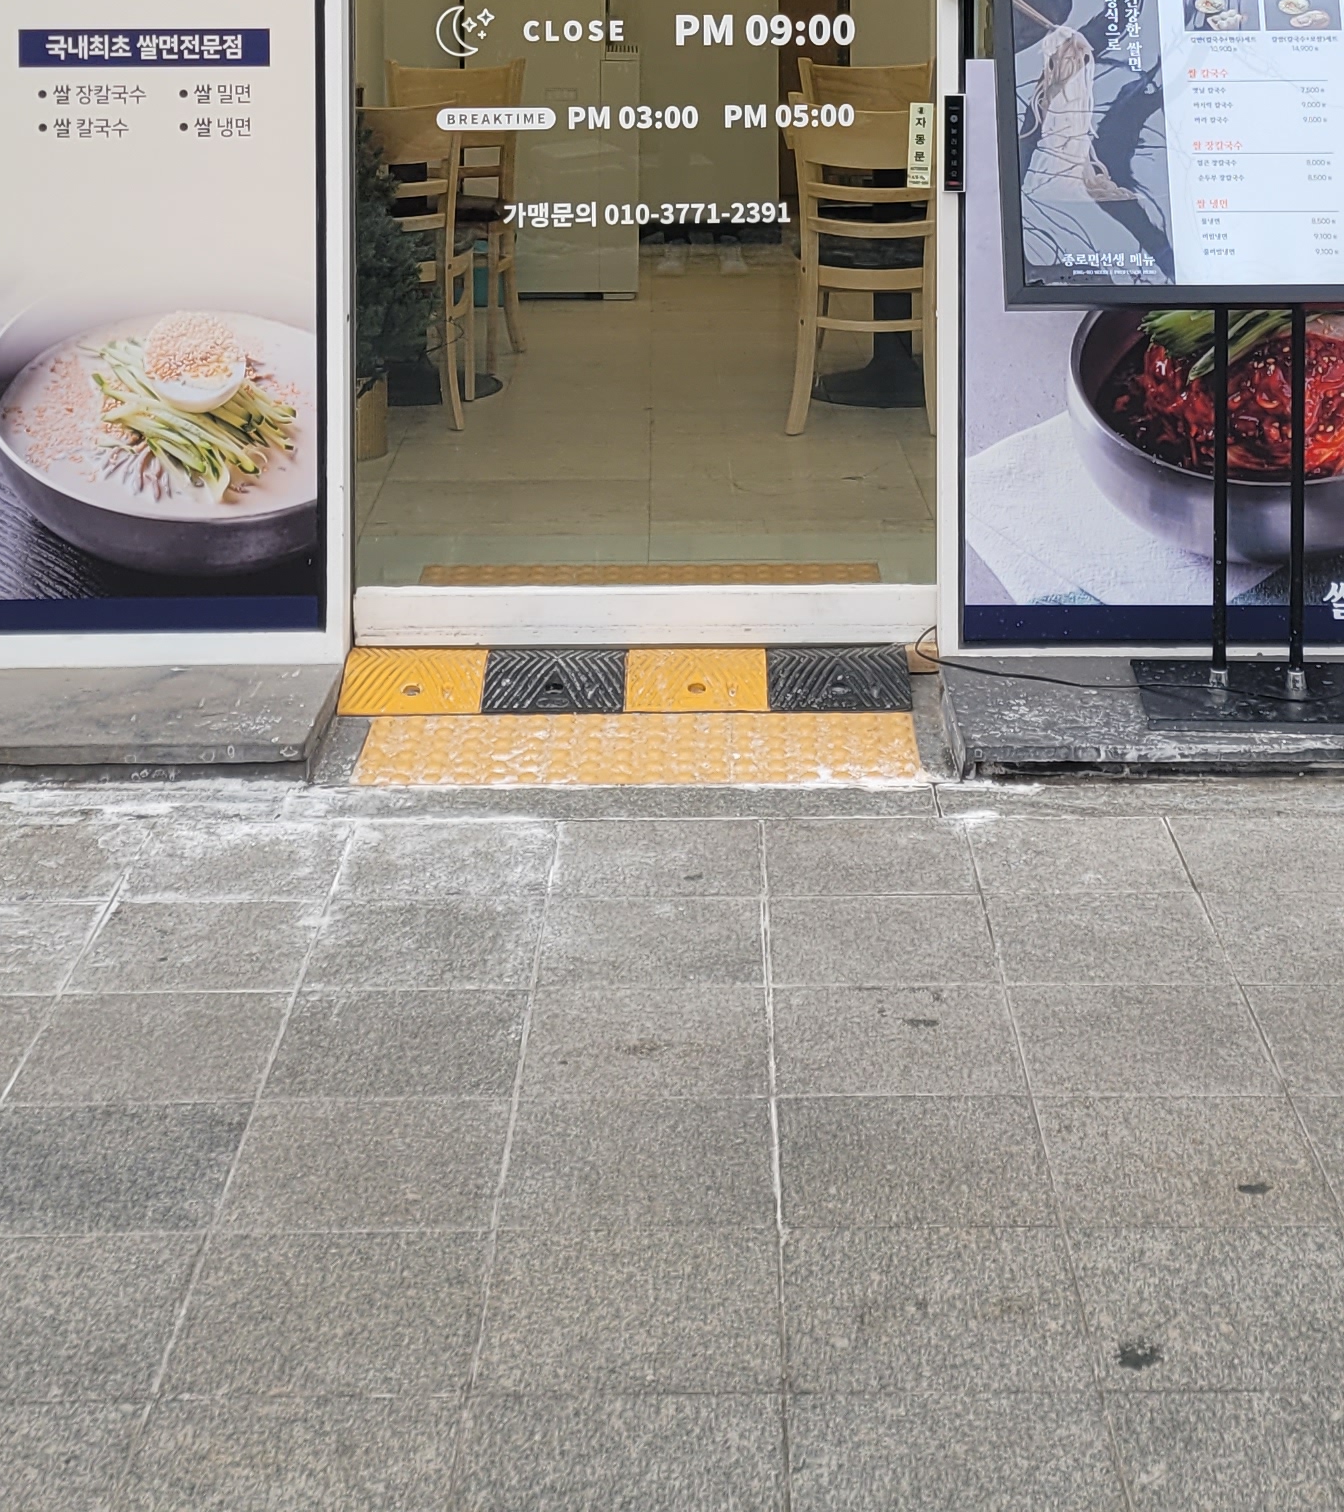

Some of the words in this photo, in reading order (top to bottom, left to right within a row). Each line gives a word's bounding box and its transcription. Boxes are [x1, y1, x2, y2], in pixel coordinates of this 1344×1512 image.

[523, 20, 626, 43] CLOSE
[675, 14, 735, 47] PM
[745, 13, 857, 47] 09:00
[45, 35, 132, 60] 국내최초
[136, 35, 244, 60] 쌀면전문점
[52, 85, 71, 104] 쌀
[75, 84, 147, 105] 장칼국수
[194, 84, 212, 104] 쌀
[217, 84, 251, 104] 밀면
[52, 118, 71, 138] 쌀
[76, 118, 129, 138] 칼국수
[194, 117, 212, 137] 쌀
[217, 117, 251, 137] 냉면
[446, 113, 547, 126] BREAKTIME
[568, 106, 611, 130] PM
[618, 106, 699, 130] 03:00
[724, 105, 768, 129] PM
[774, 104, 855, 129] 05:00
[915, 117, 926, 162] 자동문
[502, 201, 598, 229] 가맹문의
[603, 201, 792, 226] 010-3771-2391
[1129, 252, 1156, 267] 메뉴
